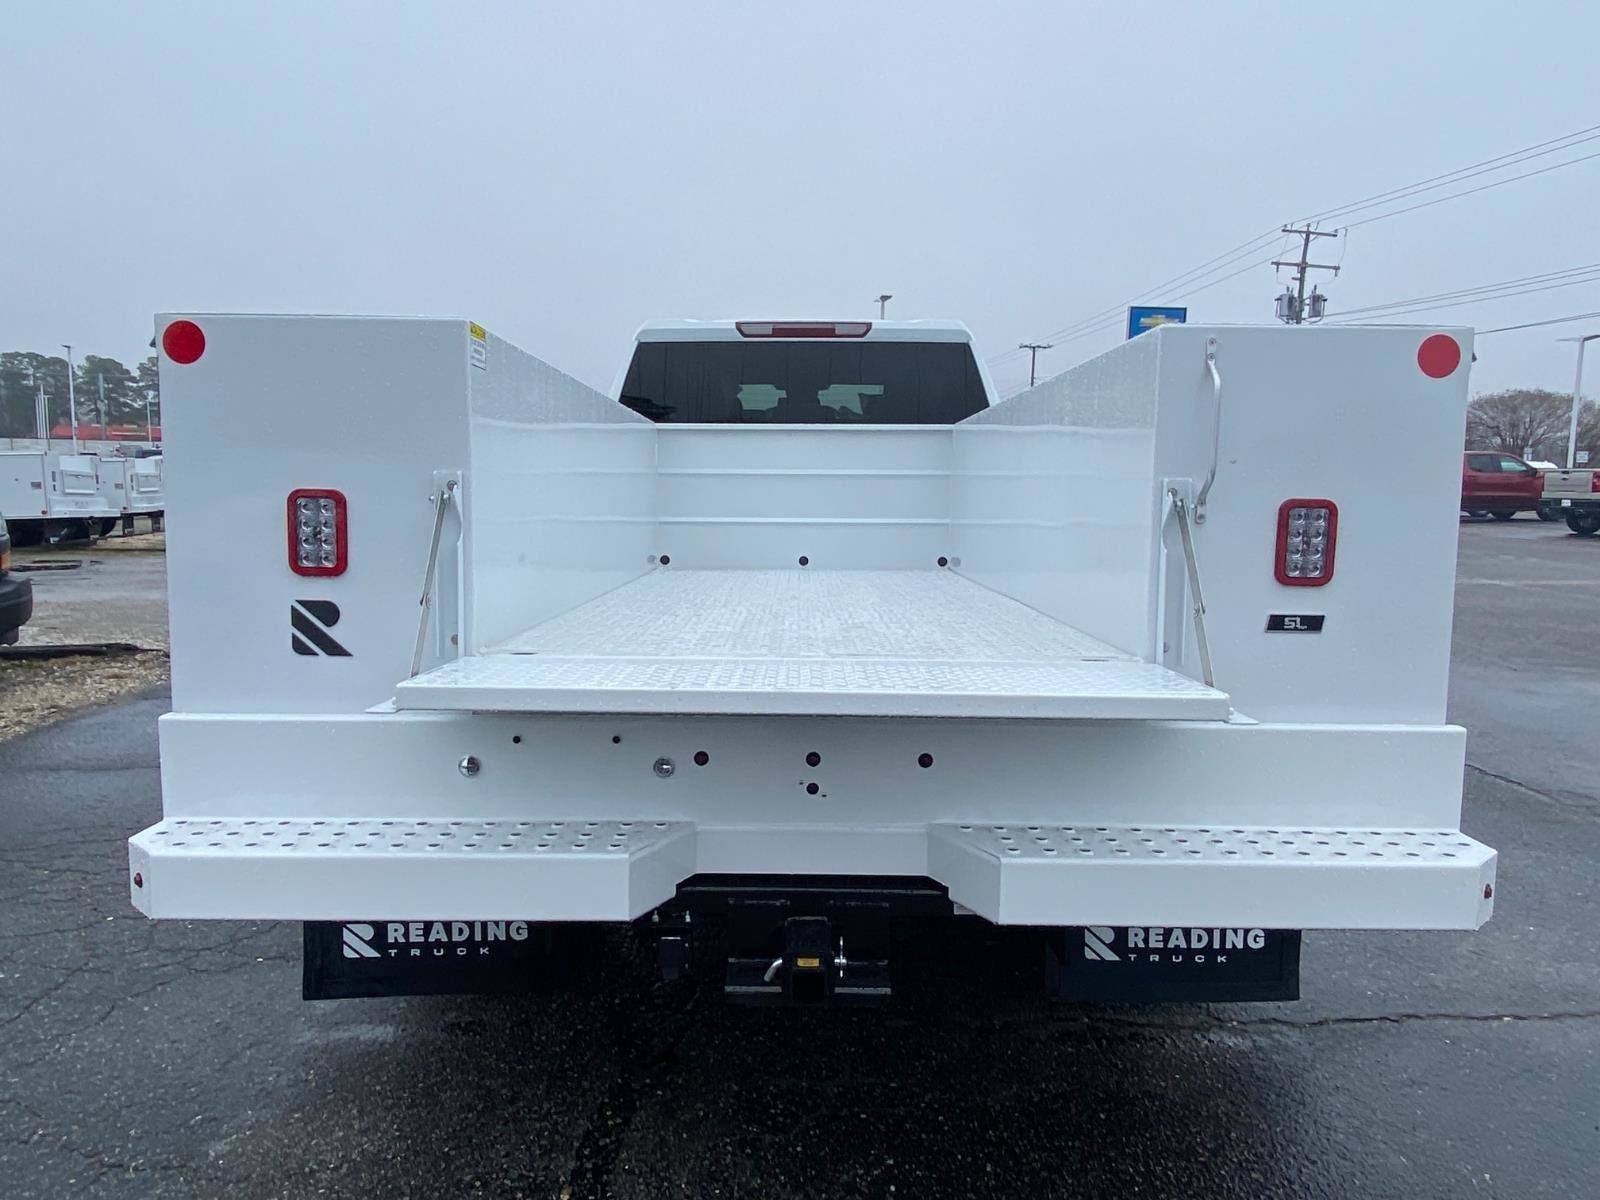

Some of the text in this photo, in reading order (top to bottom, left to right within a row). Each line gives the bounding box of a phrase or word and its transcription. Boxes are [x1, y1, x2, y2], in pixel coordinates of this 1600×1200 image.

[387, 921, 529, 943] READING
[1127, 927, 1266, 949] READING
[388, 947, 490, 957] TRUCK
[1128, 954, 1228, 963] TRUCK
